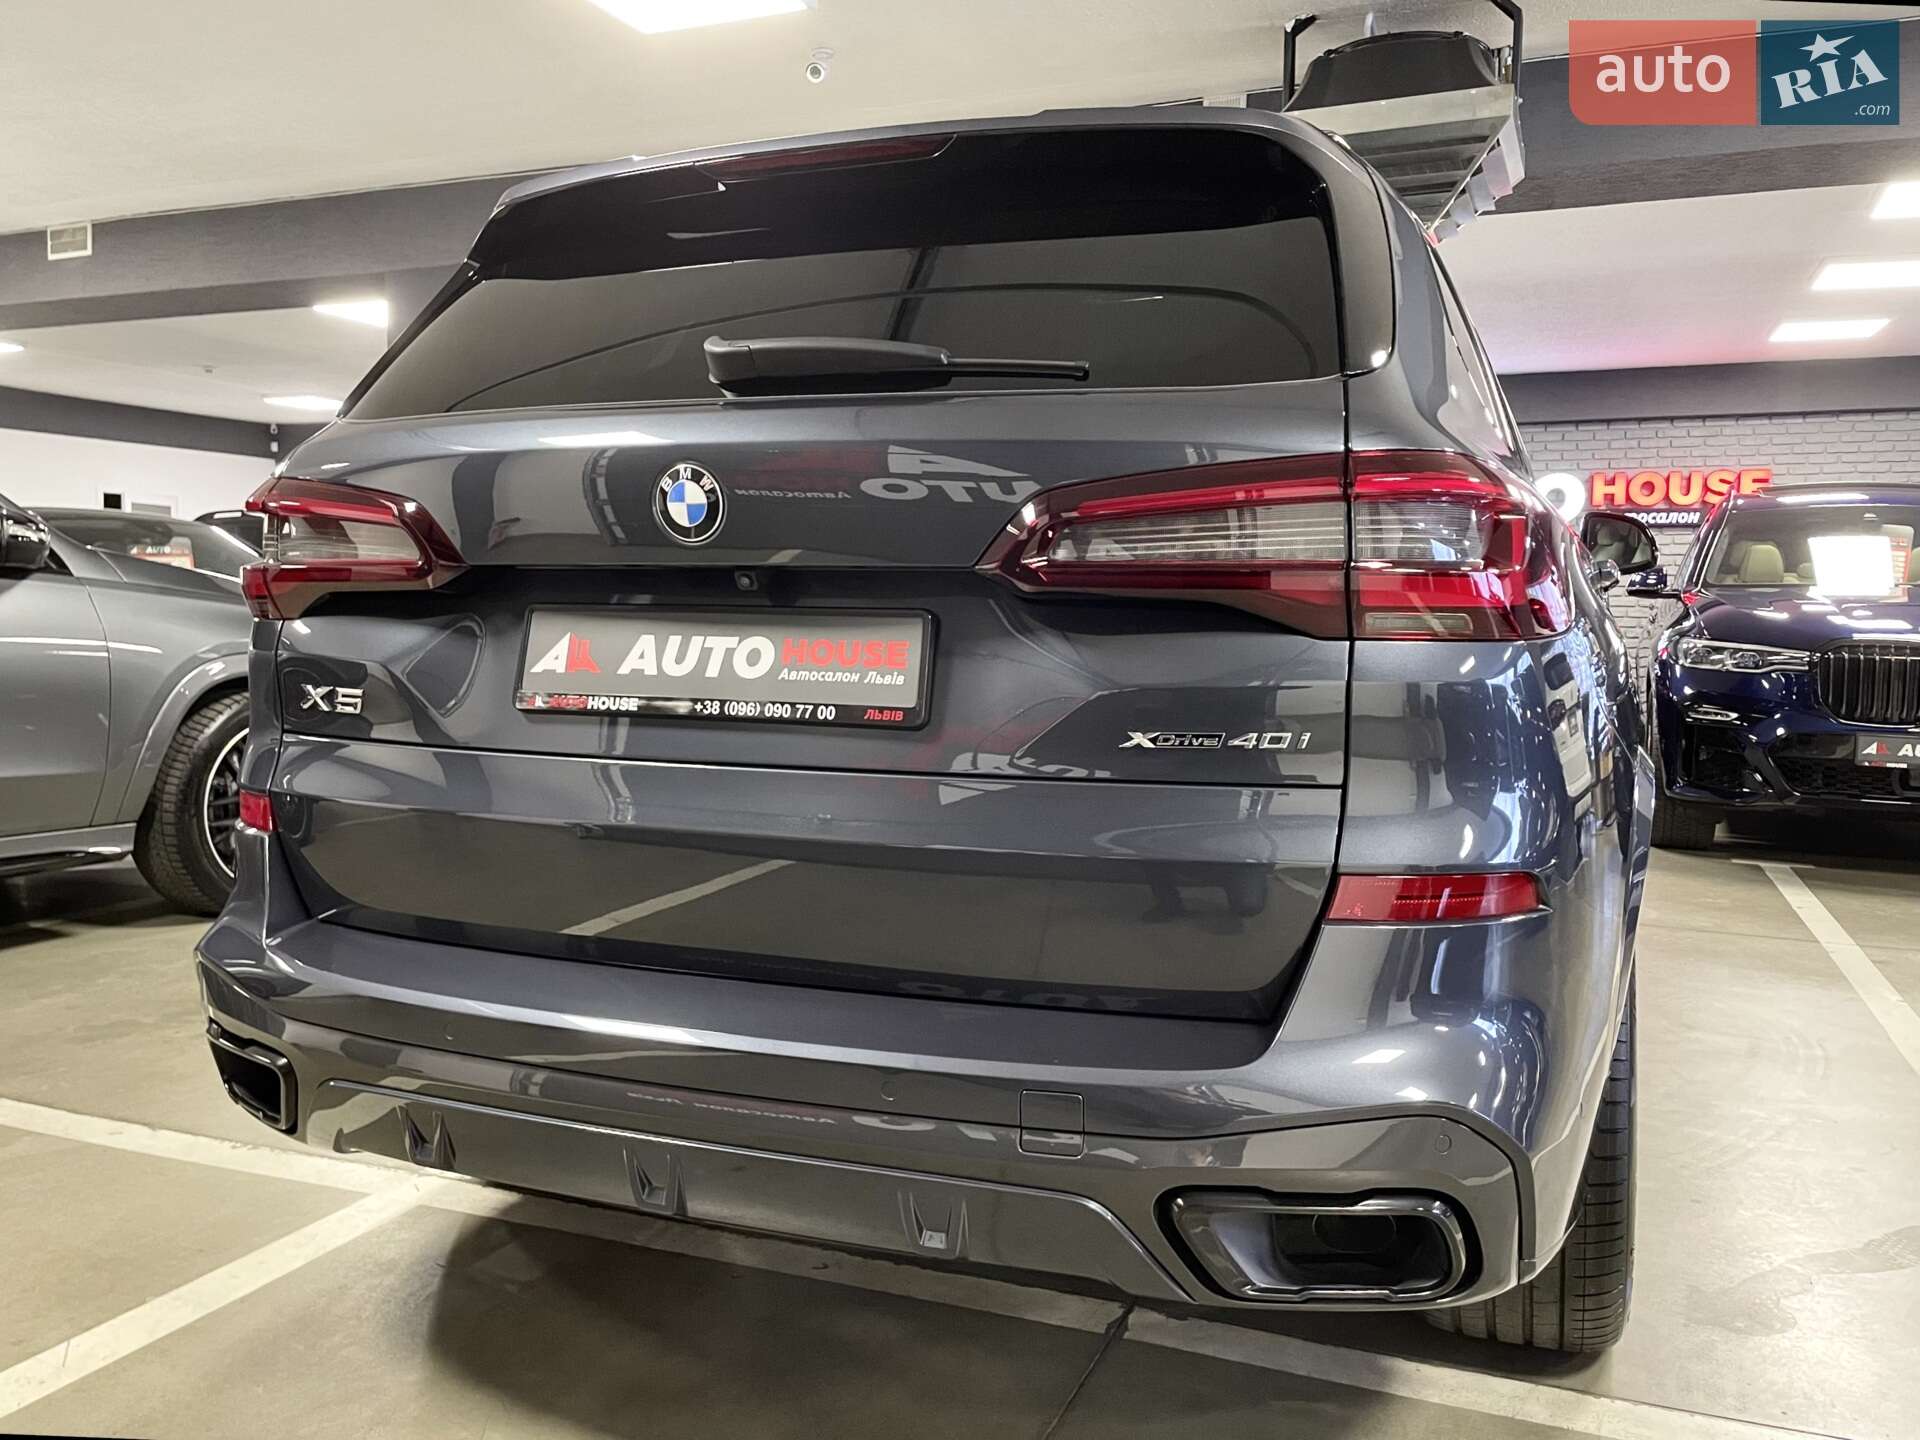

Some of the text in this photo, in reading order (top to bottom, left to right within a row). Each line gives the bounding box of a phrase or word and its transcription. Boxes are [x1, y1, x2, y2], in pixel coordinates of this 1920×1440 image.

[661, 467, 715, 492] BMW
[1589, 468, 1772, 507] HOUSE
[616, 634, 776, 680] AUTO
[781, 638, 910, 669] HOUSE
[778, 667, 905, 686] Автосалон Львів
[300, 684, 364, 714] X5
[694, 700, 836, 720] +38 (096) 090 77 00
